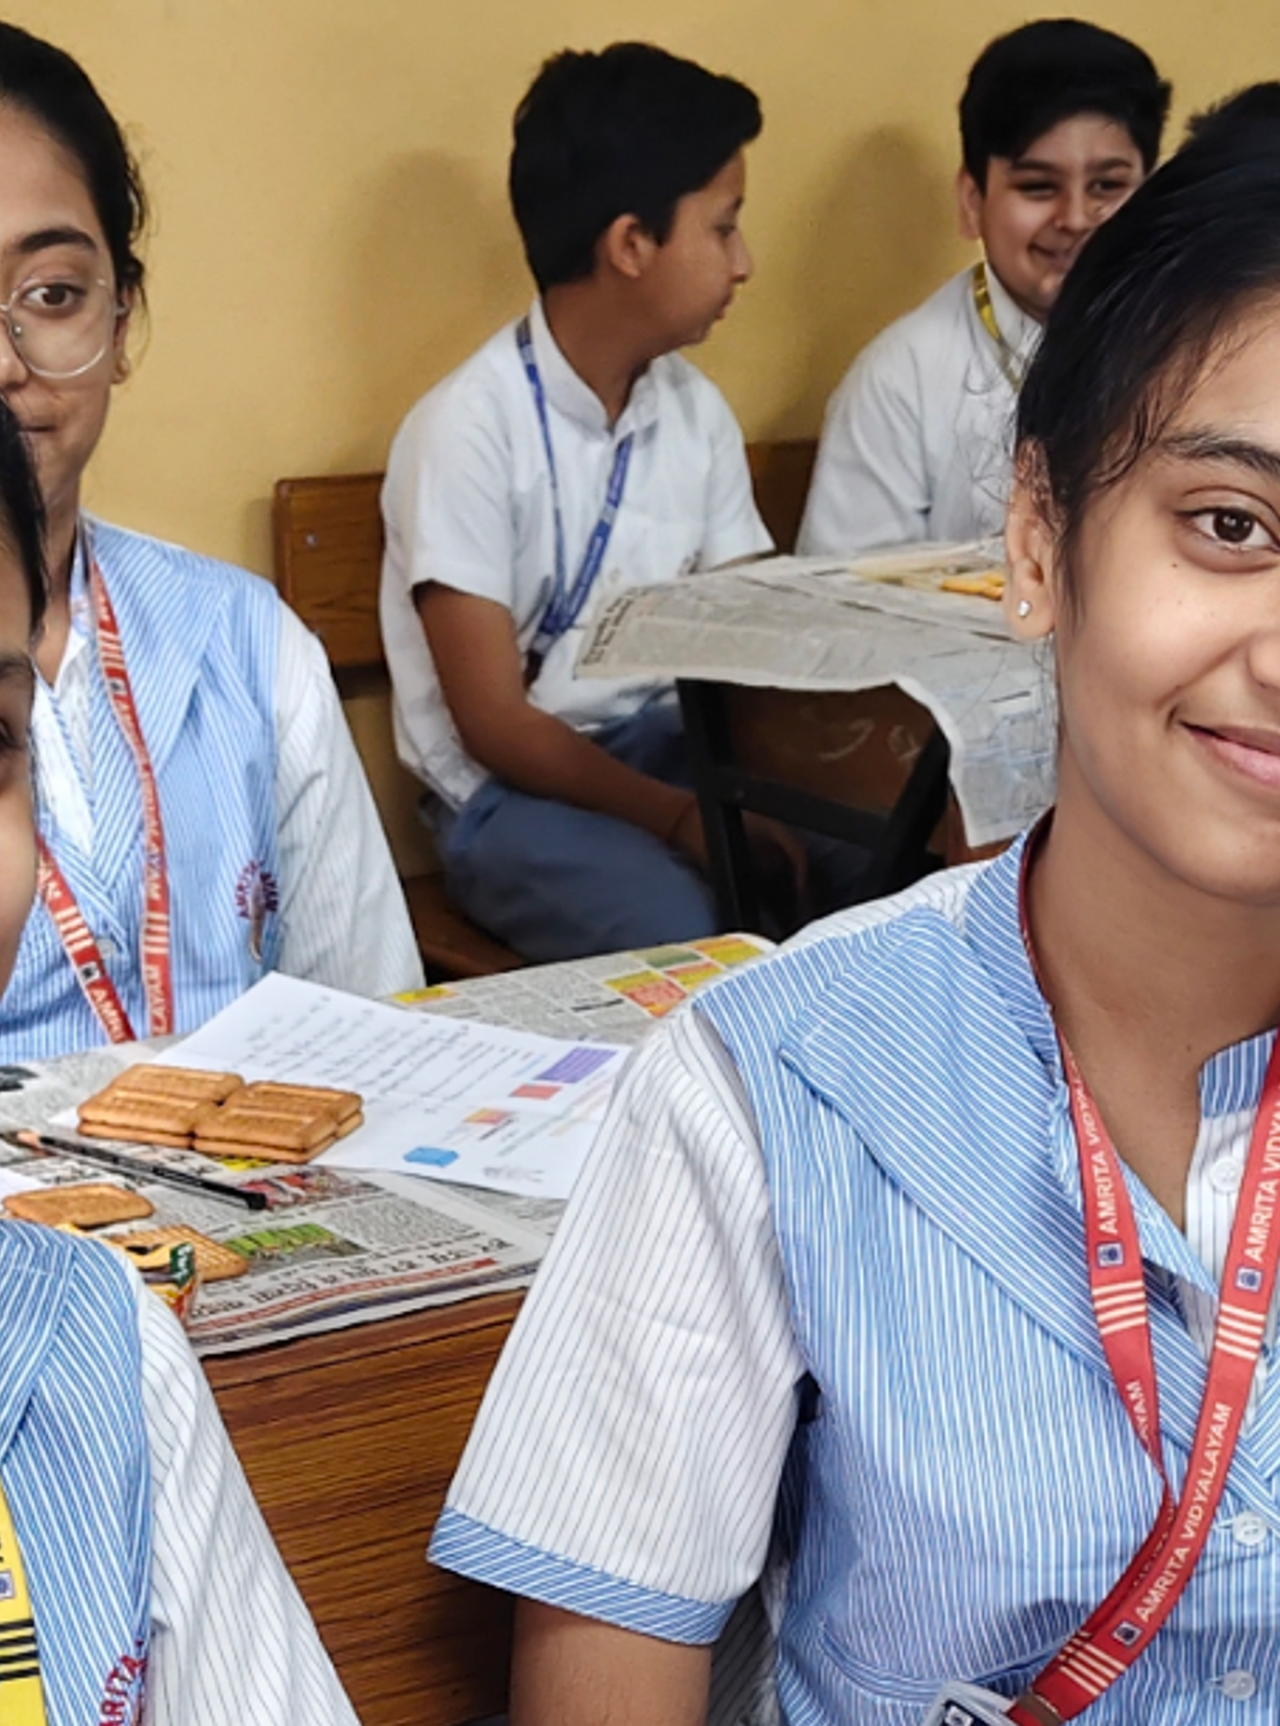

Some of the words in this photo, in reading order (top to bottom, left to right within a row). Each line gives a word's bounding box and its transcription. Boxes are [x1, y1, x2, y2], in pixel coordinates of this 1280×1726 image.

[1089, 1149, 1120, 1236] AMRITA
[1133, 1543, 1193, 1625] AMRITA
[1175, 1399, 1249, 1540] VIDYALAYAM
